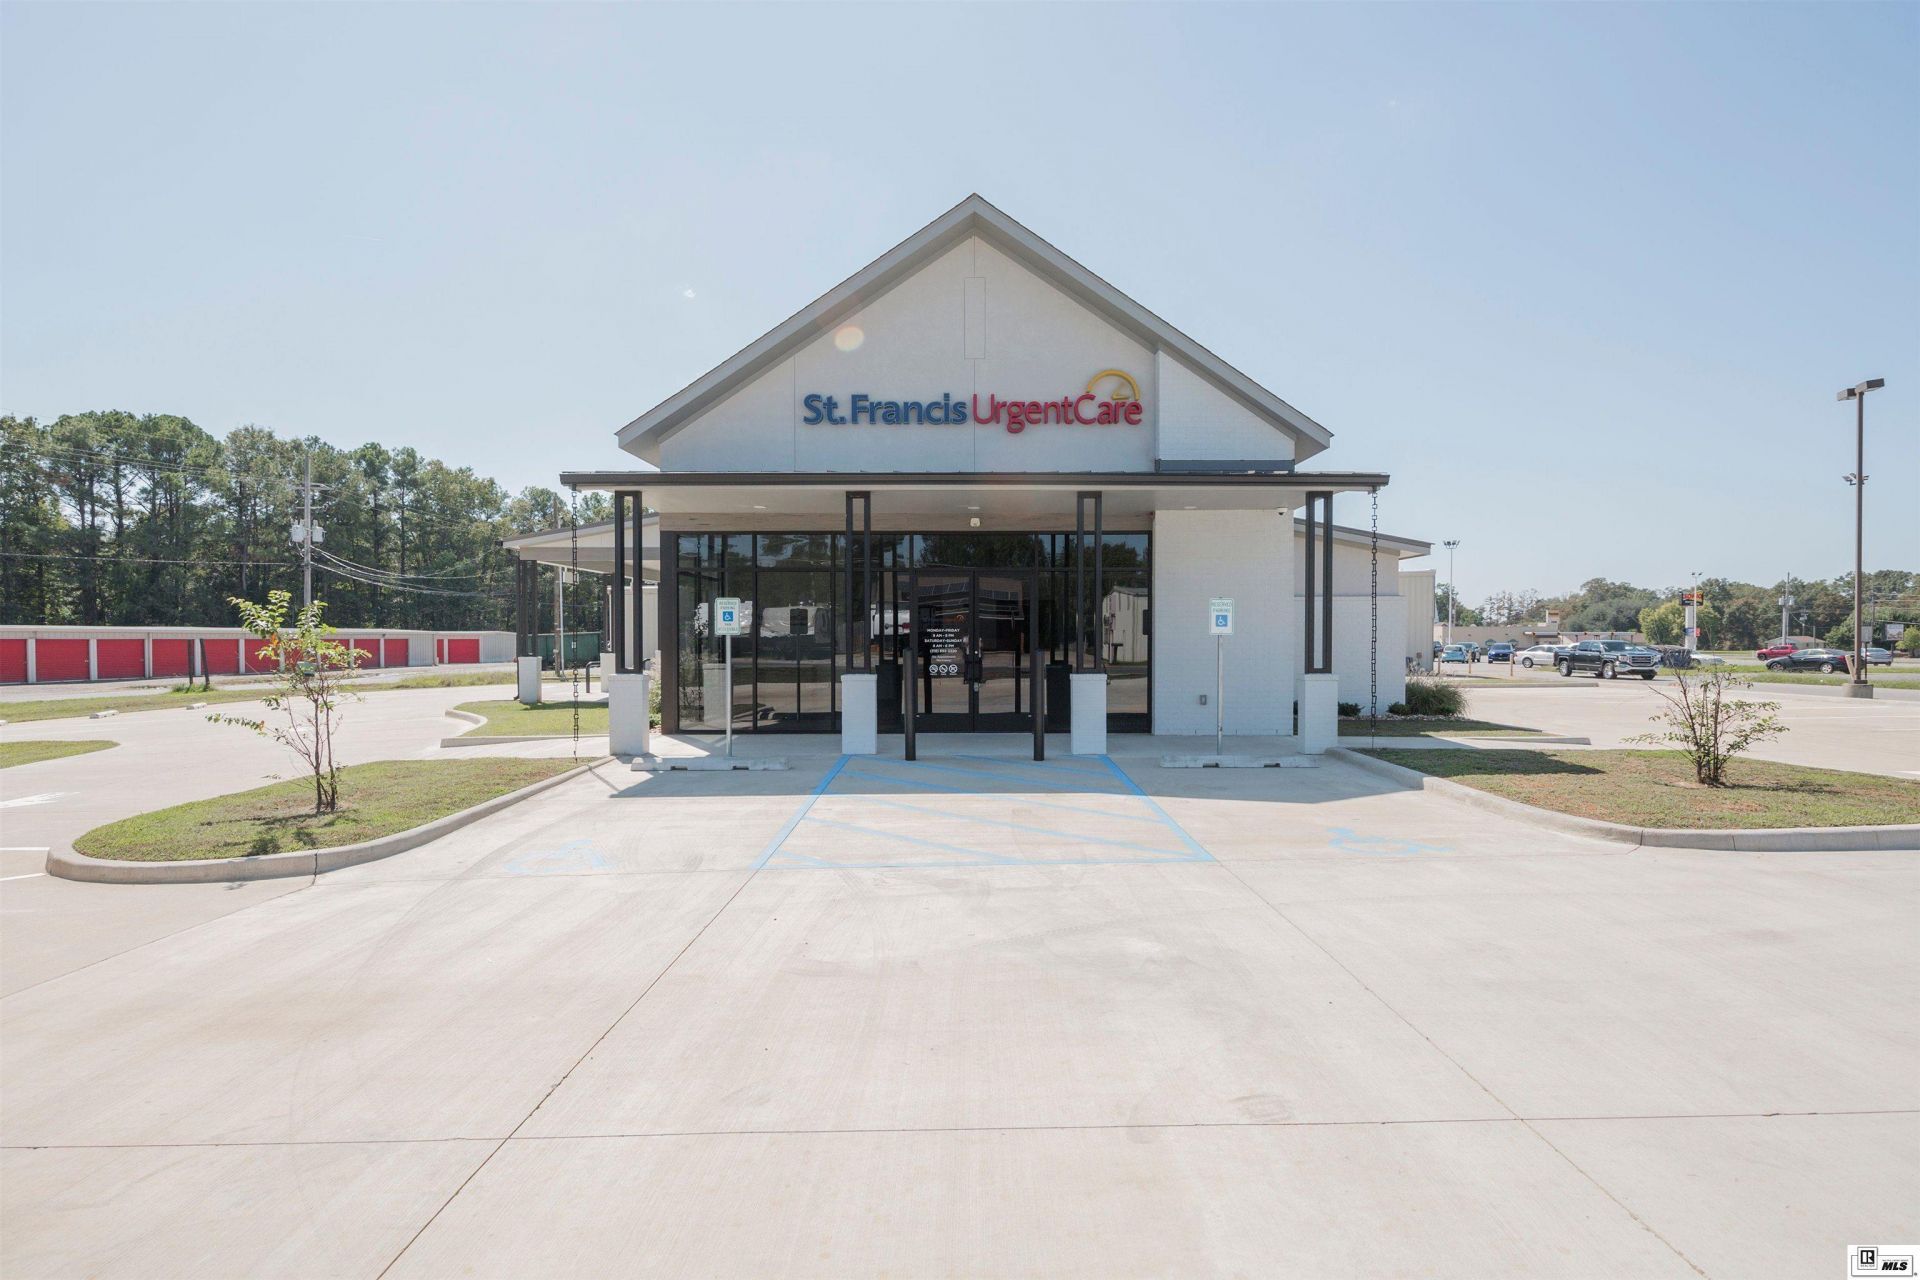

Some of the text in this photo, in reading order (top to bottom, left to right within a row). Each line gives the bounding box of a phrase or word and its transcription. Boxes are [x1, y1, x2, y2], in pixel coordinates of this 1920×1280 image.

[803, 392, 1143, 434] St. Francis UrgentCare
